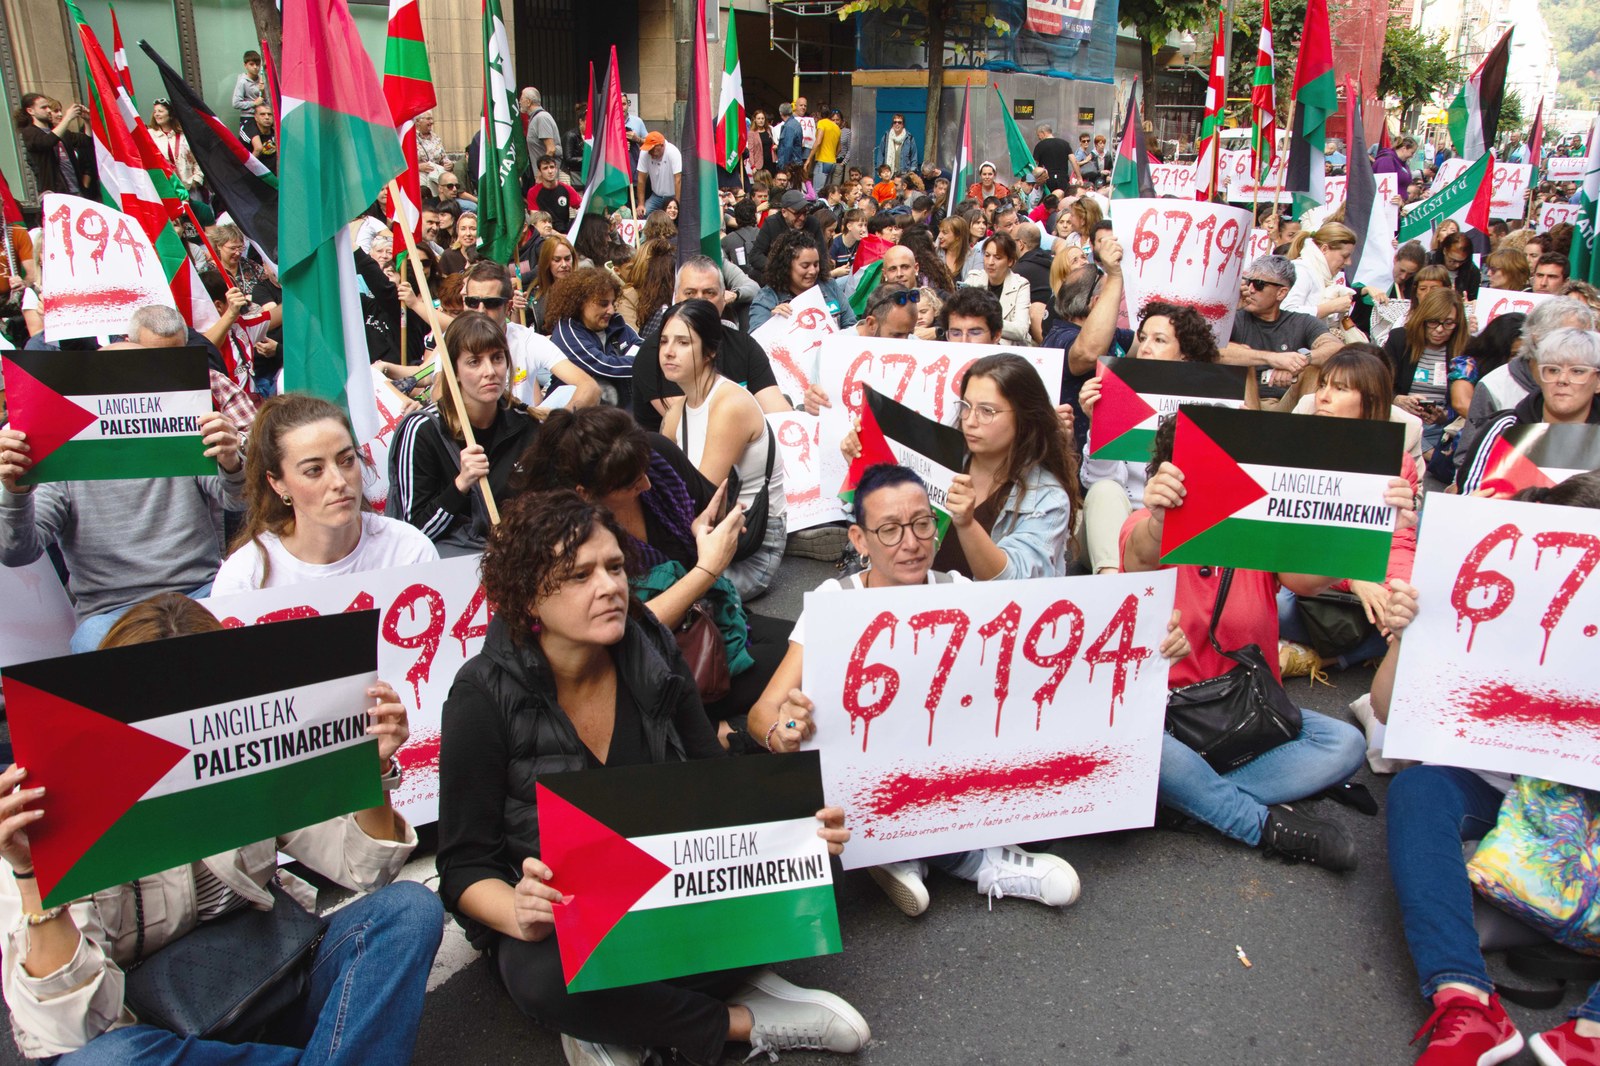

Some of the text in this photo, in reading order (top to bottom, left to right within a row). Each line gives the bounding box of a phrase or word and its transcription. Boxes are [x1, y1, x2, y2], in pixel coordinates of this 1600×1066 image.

[98, 397, 162, 415] LANGILEAK
[1271, 472, 1343, 496] LANGILEAK
[1267, 497, 1392, 526] PALESTINAREKIN!
[190, 696, 298, 745] LANGILEAK
[193, 712, 372, 780] PALESTINAREKIN!
[879, 830, 918, 840] 2025eko
[1071, 804, 1095, 814] 2025
[674, 831, 758, 866] LANGILEAK
[674, 854, 825, 898] PALESTINAREKIN!
